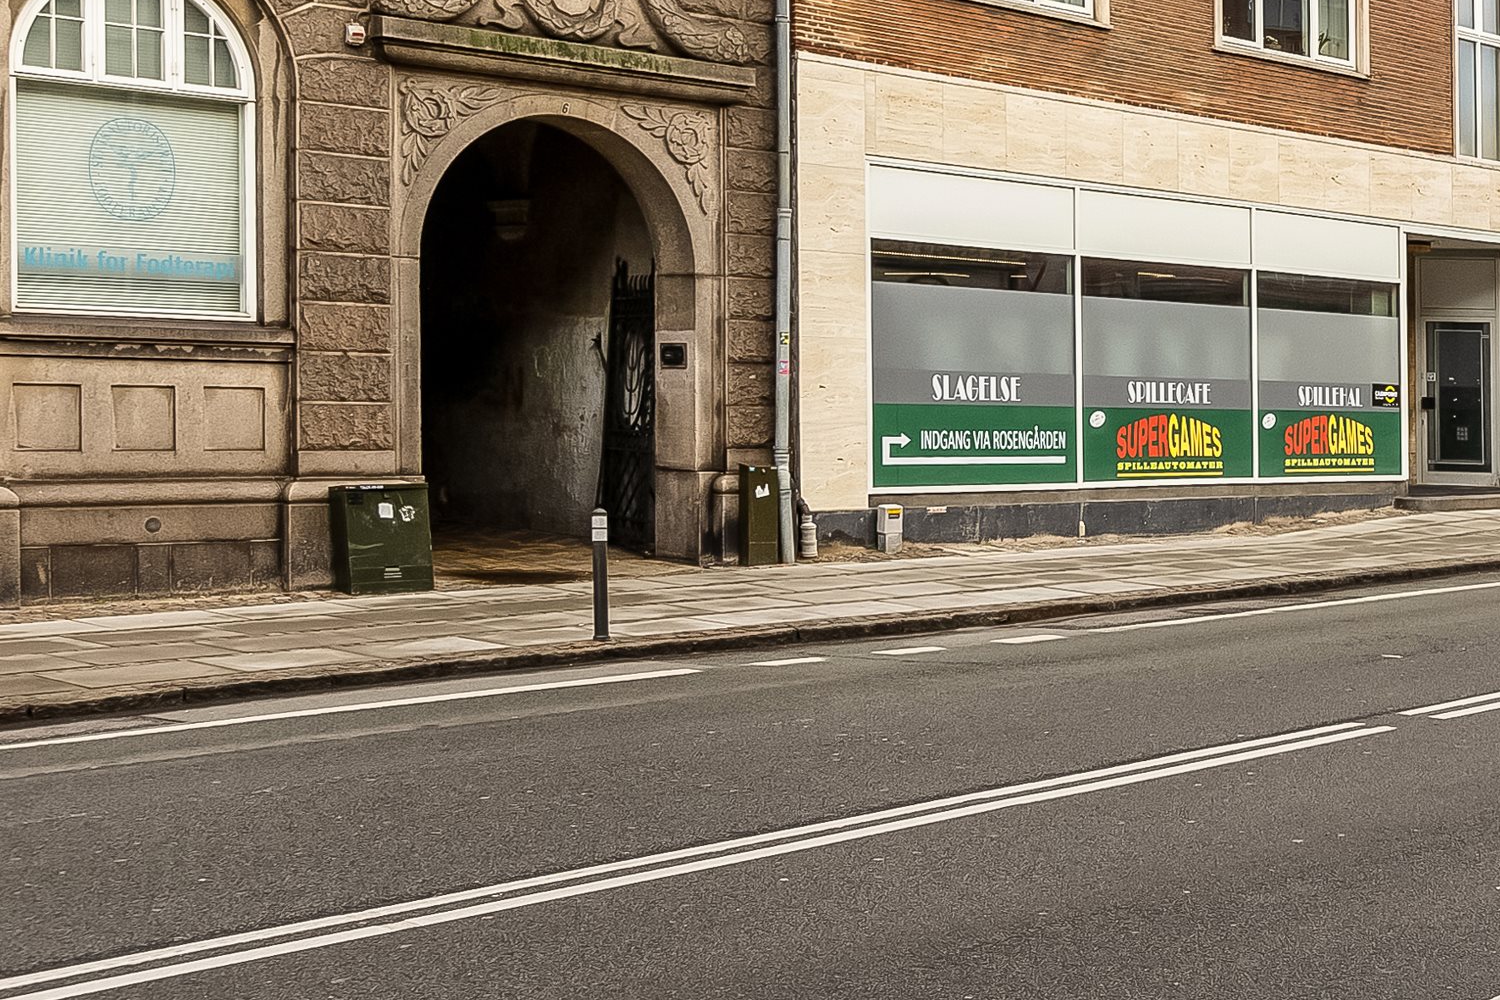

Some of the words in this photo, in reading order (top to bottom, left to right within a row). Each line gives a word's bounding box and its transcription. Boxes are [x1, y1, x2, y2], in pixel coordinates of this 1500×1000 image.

[562, 102, 569, 114] 6
[23, 246, 89, 269] Klinik
[96, 249, 129, 273] for
[135, 253, 236, 280] Fodterapi
[931, 373, 1022, 402] SLAGELSE
[1127, 380, 1212, 405] SPILLECAFE
[1298, 385, 1364, 407] SPILLEHAL
[920, 429, 971, 450] INDGANG
[971, 430, 992, 450] VIA
[993, 425, 1067, 450] ROSENGÅRDEN
[1115, 413, 1223, 459] SUPERGAMES
[1284, 413, 1375, 456] SUPERGAMES
[1117, 460, 1224, 471] SPILLEAUTOMATER
[1284, 458, 1375, 467] SPILLEAUTOMATER
